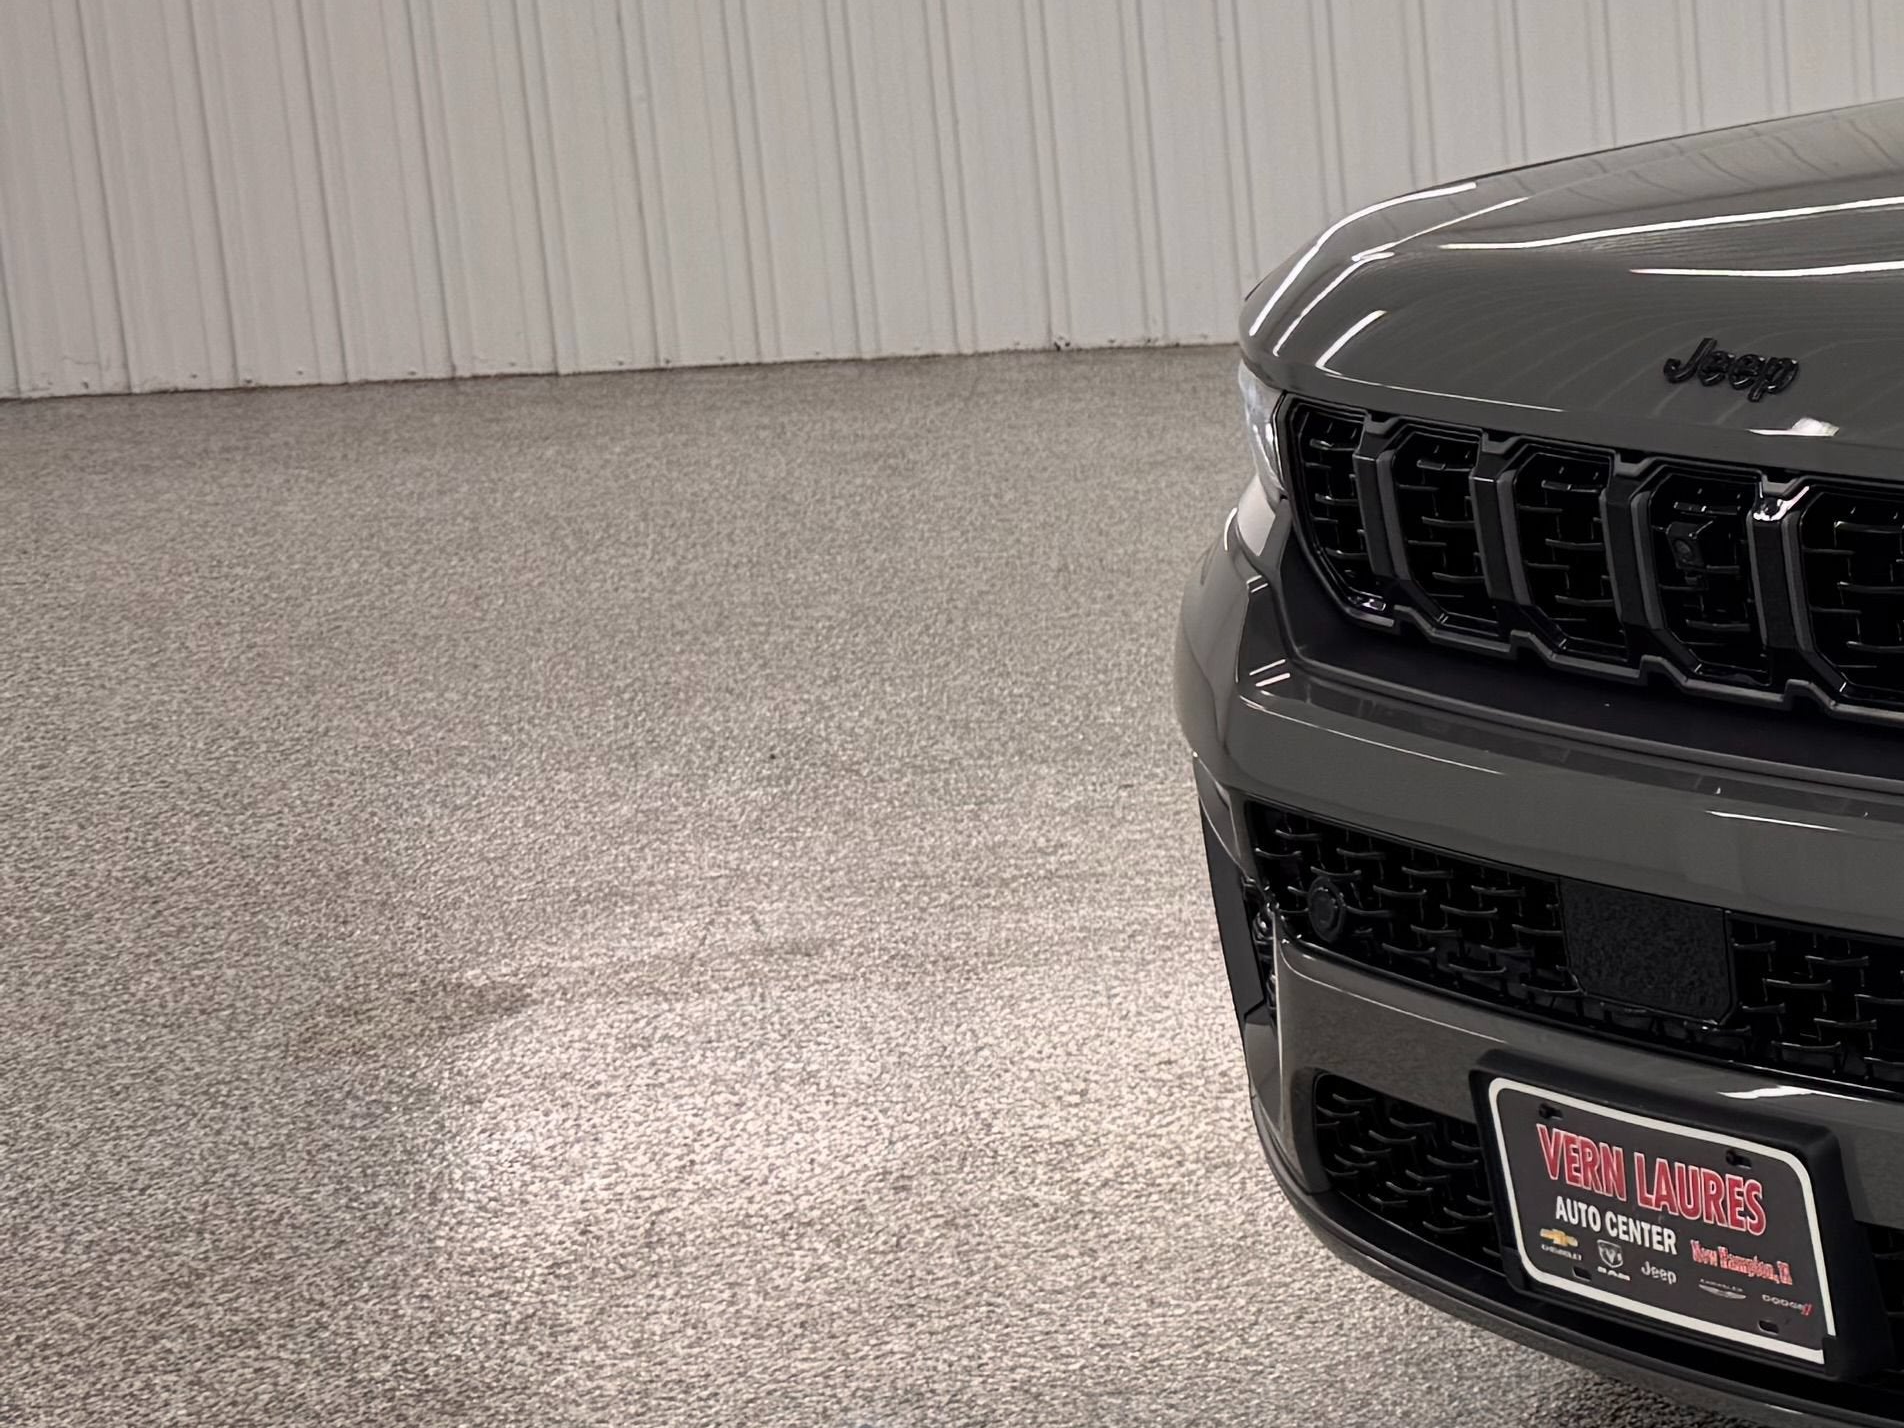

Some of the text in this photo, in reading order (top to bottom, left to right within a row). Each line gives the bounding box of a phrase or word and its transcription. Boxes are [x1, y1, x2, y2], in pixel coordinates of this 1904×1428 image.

[1664, 337, 1799, 403] Jeep
[1536, 1123, 1767, 1237] VERN LAURES
[1555, 1195, 1601, 1233] AUTO
[1605, 1215, 1678, 1256] CENTER
[1641, 1260, 1678, 1285] Jeep
